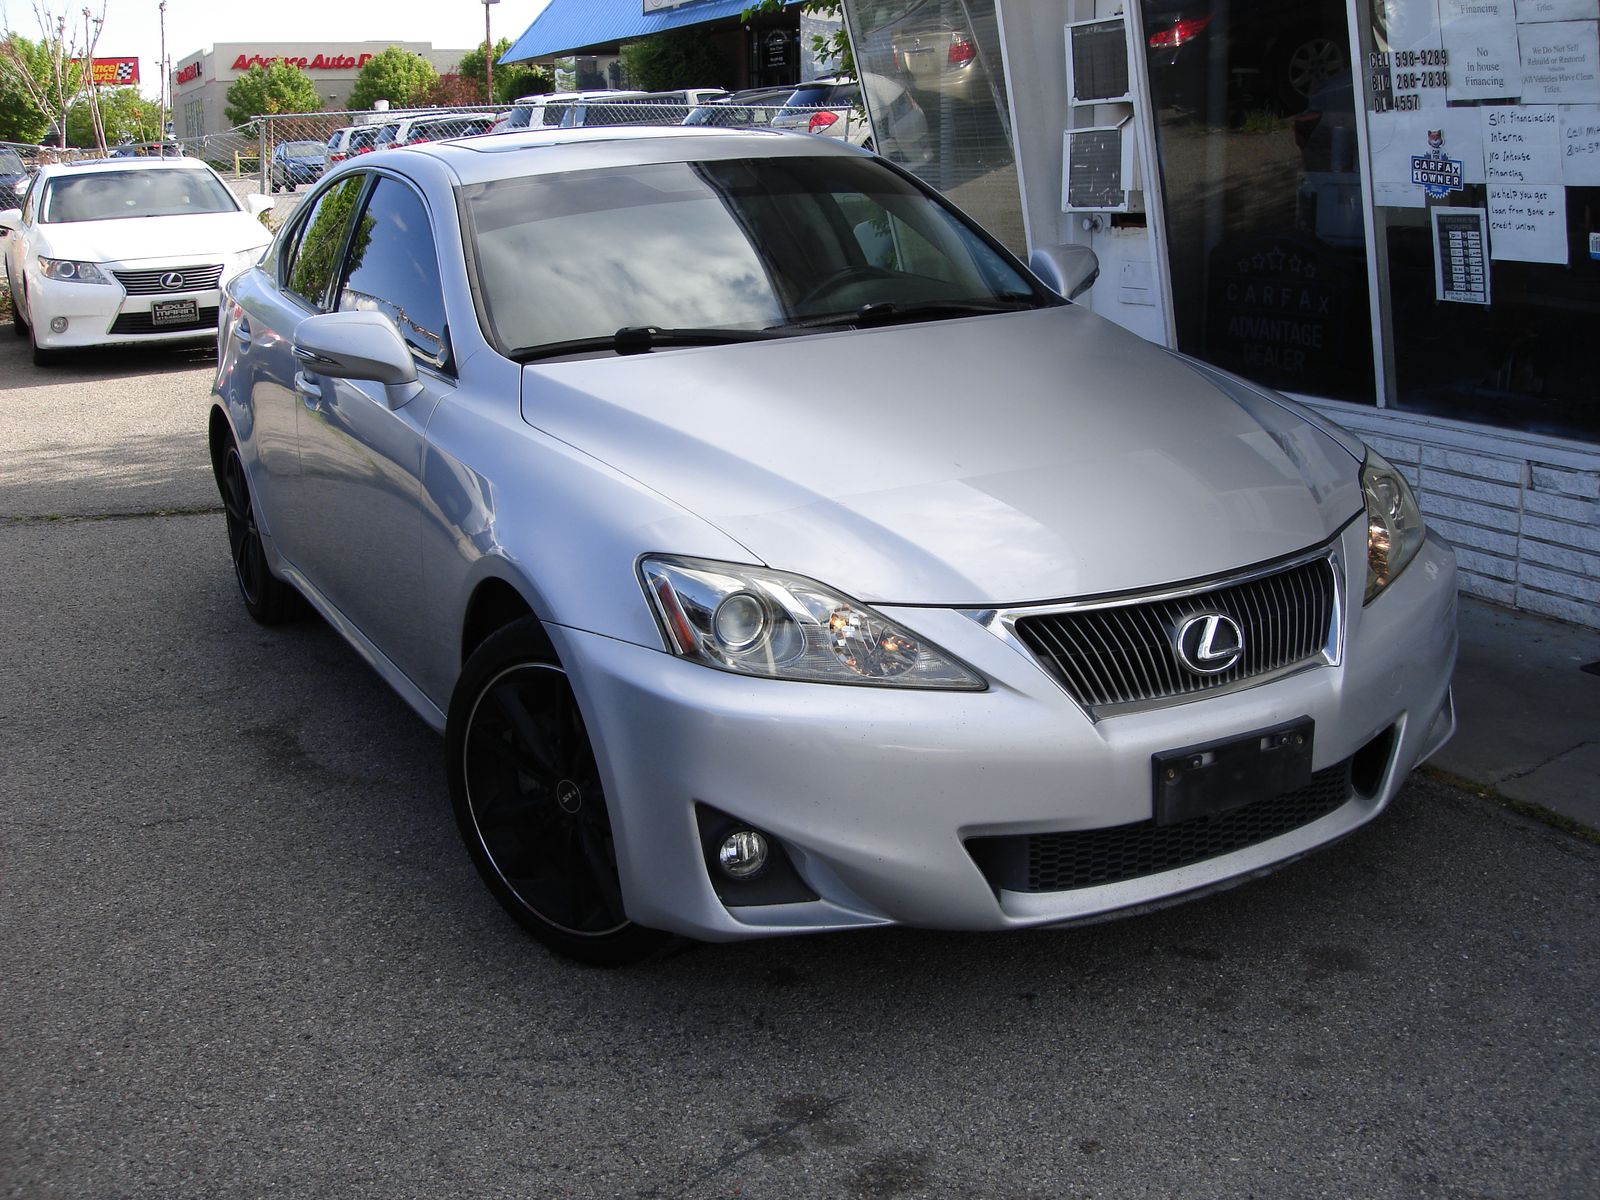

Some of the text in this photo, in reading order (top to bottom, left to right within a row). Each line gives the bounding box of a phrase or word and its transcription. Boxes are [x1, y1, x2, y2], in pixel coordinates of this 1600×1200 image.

[1460, 4, 1498, 15] Financing
[1476, 48, 1488, 57] No
[1542, 46, 1552, 54] Do
[309, 54, 356, 69] Auto
[1370, 50, 1447, 68] CEL 598-9289
[1467, 62, 1499, 71] in house
[1397, 71, 1448, 89] 288-2838
[1465, 76, 1504, 88] Financing
[1394, 94, 1419, 111] 4557
[1488, 111, 1505, 126] Sin
[1414, 160, 1459, 175] CARFAX
[1414, 171, 1459, 186] 1 OWNER
[1534, 192, 1547, 203] get
[1508, 205, 1524, 214] from
[1226, 283, 1329, 314] CARFAX
[1227, 315, 1323, 348] ADVANTAGE
